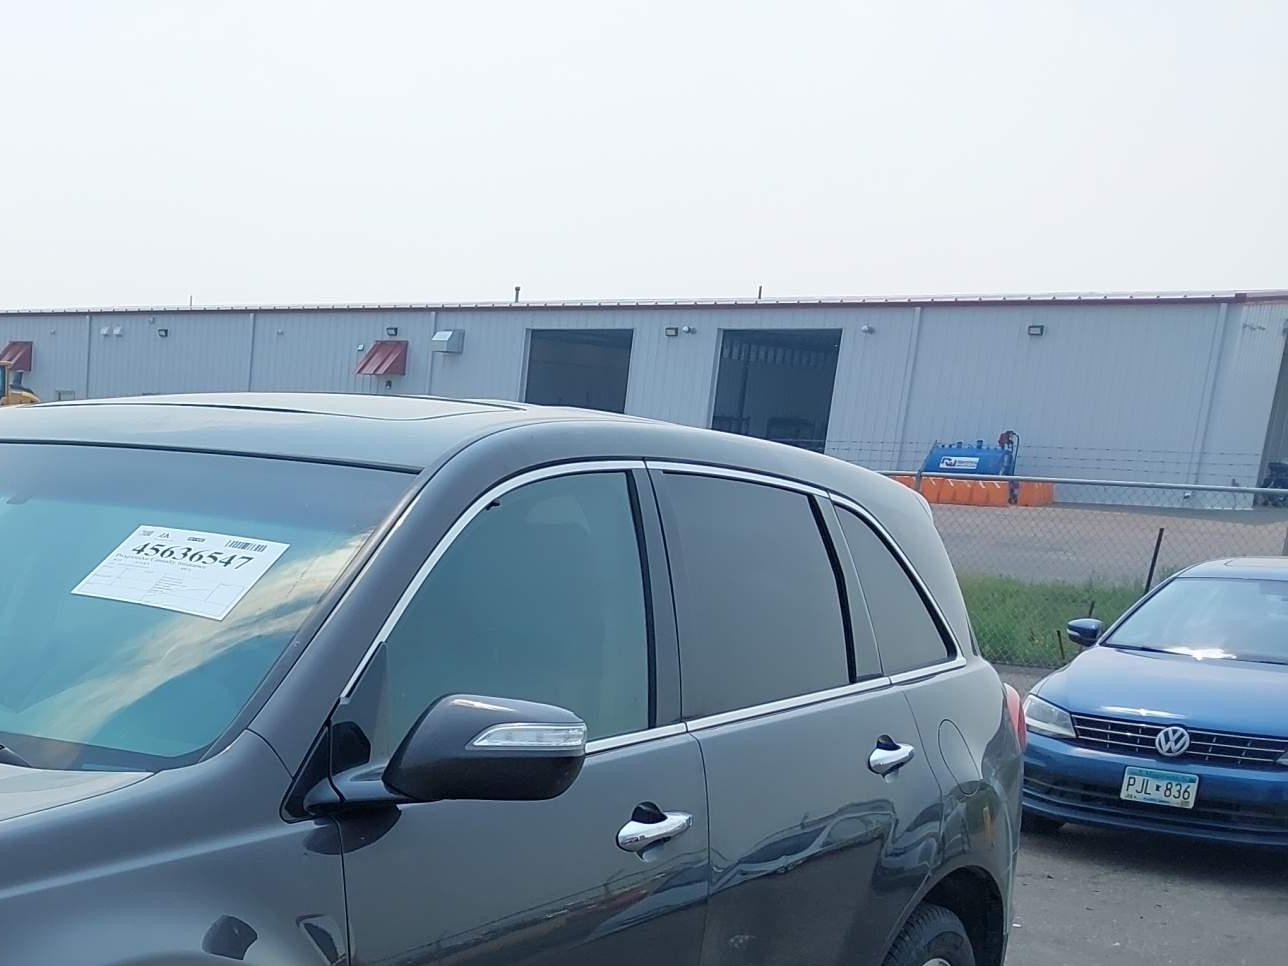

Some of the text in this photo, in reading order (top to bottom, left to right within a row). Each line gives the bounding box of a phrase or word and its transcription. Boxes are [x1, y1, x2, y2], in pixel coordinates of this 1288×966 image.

[132, 542, 255, 570] 45636547
[1126, 776, 1191, 801] PJL 836
